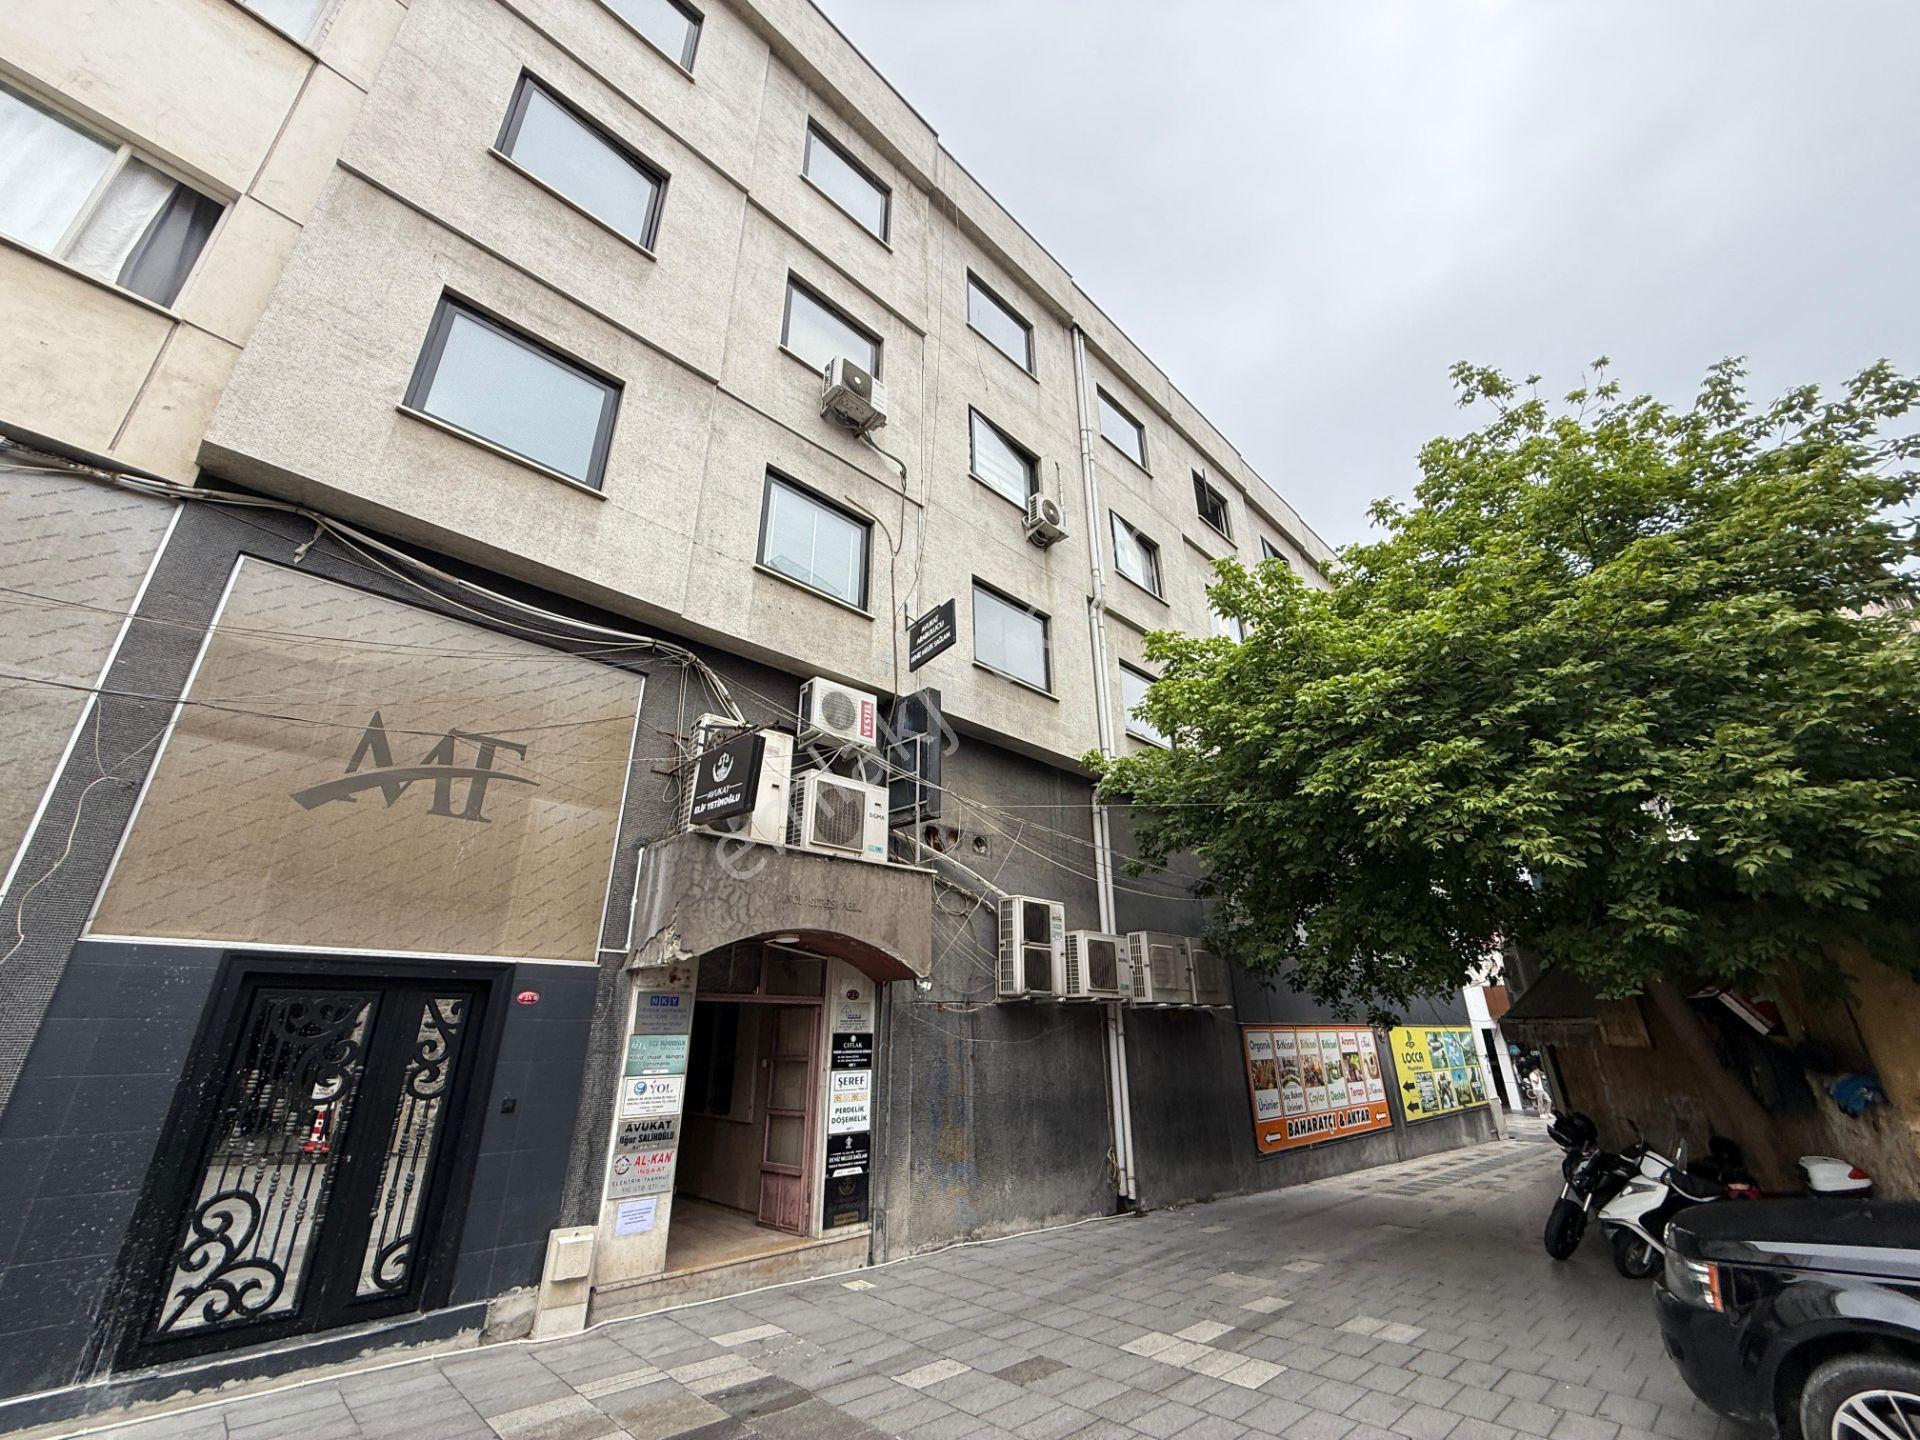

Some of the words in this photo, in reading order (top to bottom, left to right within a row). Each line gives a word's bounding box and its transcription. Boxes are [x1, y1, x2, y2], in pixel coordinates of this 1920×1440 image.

[863, 703, 873, 737] VESTEL
[707, 784, 731, 800] AVUKAT
[651, 996, 679, 1006] NKY
[1250, 1040, 1271, 1052] Organik
[1276, 1038, 1295, 1050] Bitkisel
[1401, 1052, 1424, 1064] LOCCA
[838, 1076, 864, 1087] ŞEREF
[835, 1106, 864, 1114] PERDELİK
[625, 1120, 672, 1132] AVUKAT
[831, 1115, 868, 1125] DÖŞEMELİK
[1288, 1113, 1336, 1138] BAHARATÇI
[1339, 1113, 1345, 1127] &
[1347, 1108, 1371, 1125] AKTAR
[619, 1135, 636, 1146] Uğur
[638, 1131, 675, 1143] SALİHOĞLU
[634, 1152, 672, 1167] AL-KAN
